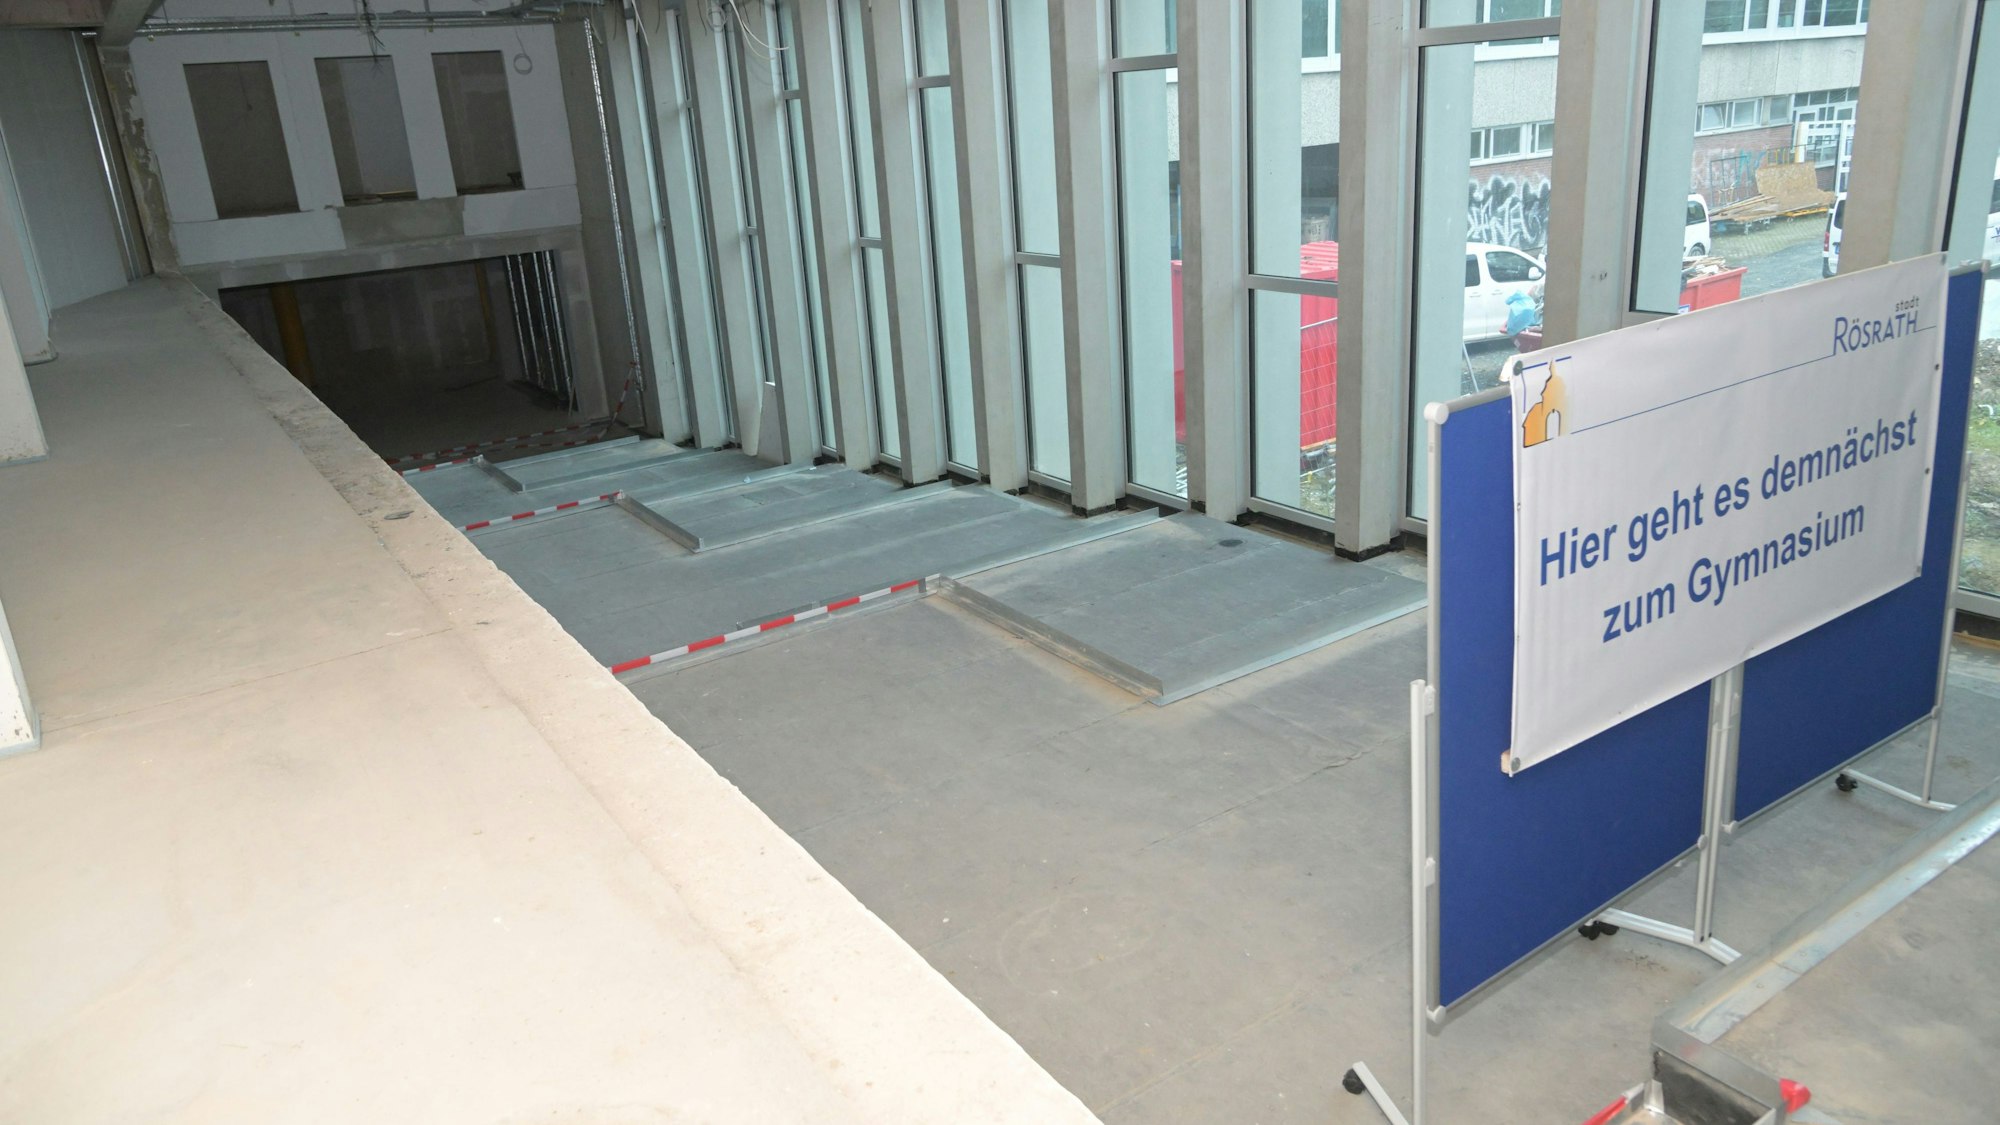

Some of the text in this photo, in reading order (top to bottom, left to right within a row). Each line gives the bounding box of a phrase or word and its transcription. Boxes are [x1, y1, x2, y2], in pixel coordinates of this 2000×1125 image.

[1833, 310, 1918, 356] RÖSRATH
[1895, 295, 1919, 312] stadt
[1540, 410, 1917, 586] Hier geht es demnächst
[1603, 504, 1864, 643] zum Gymnasium
